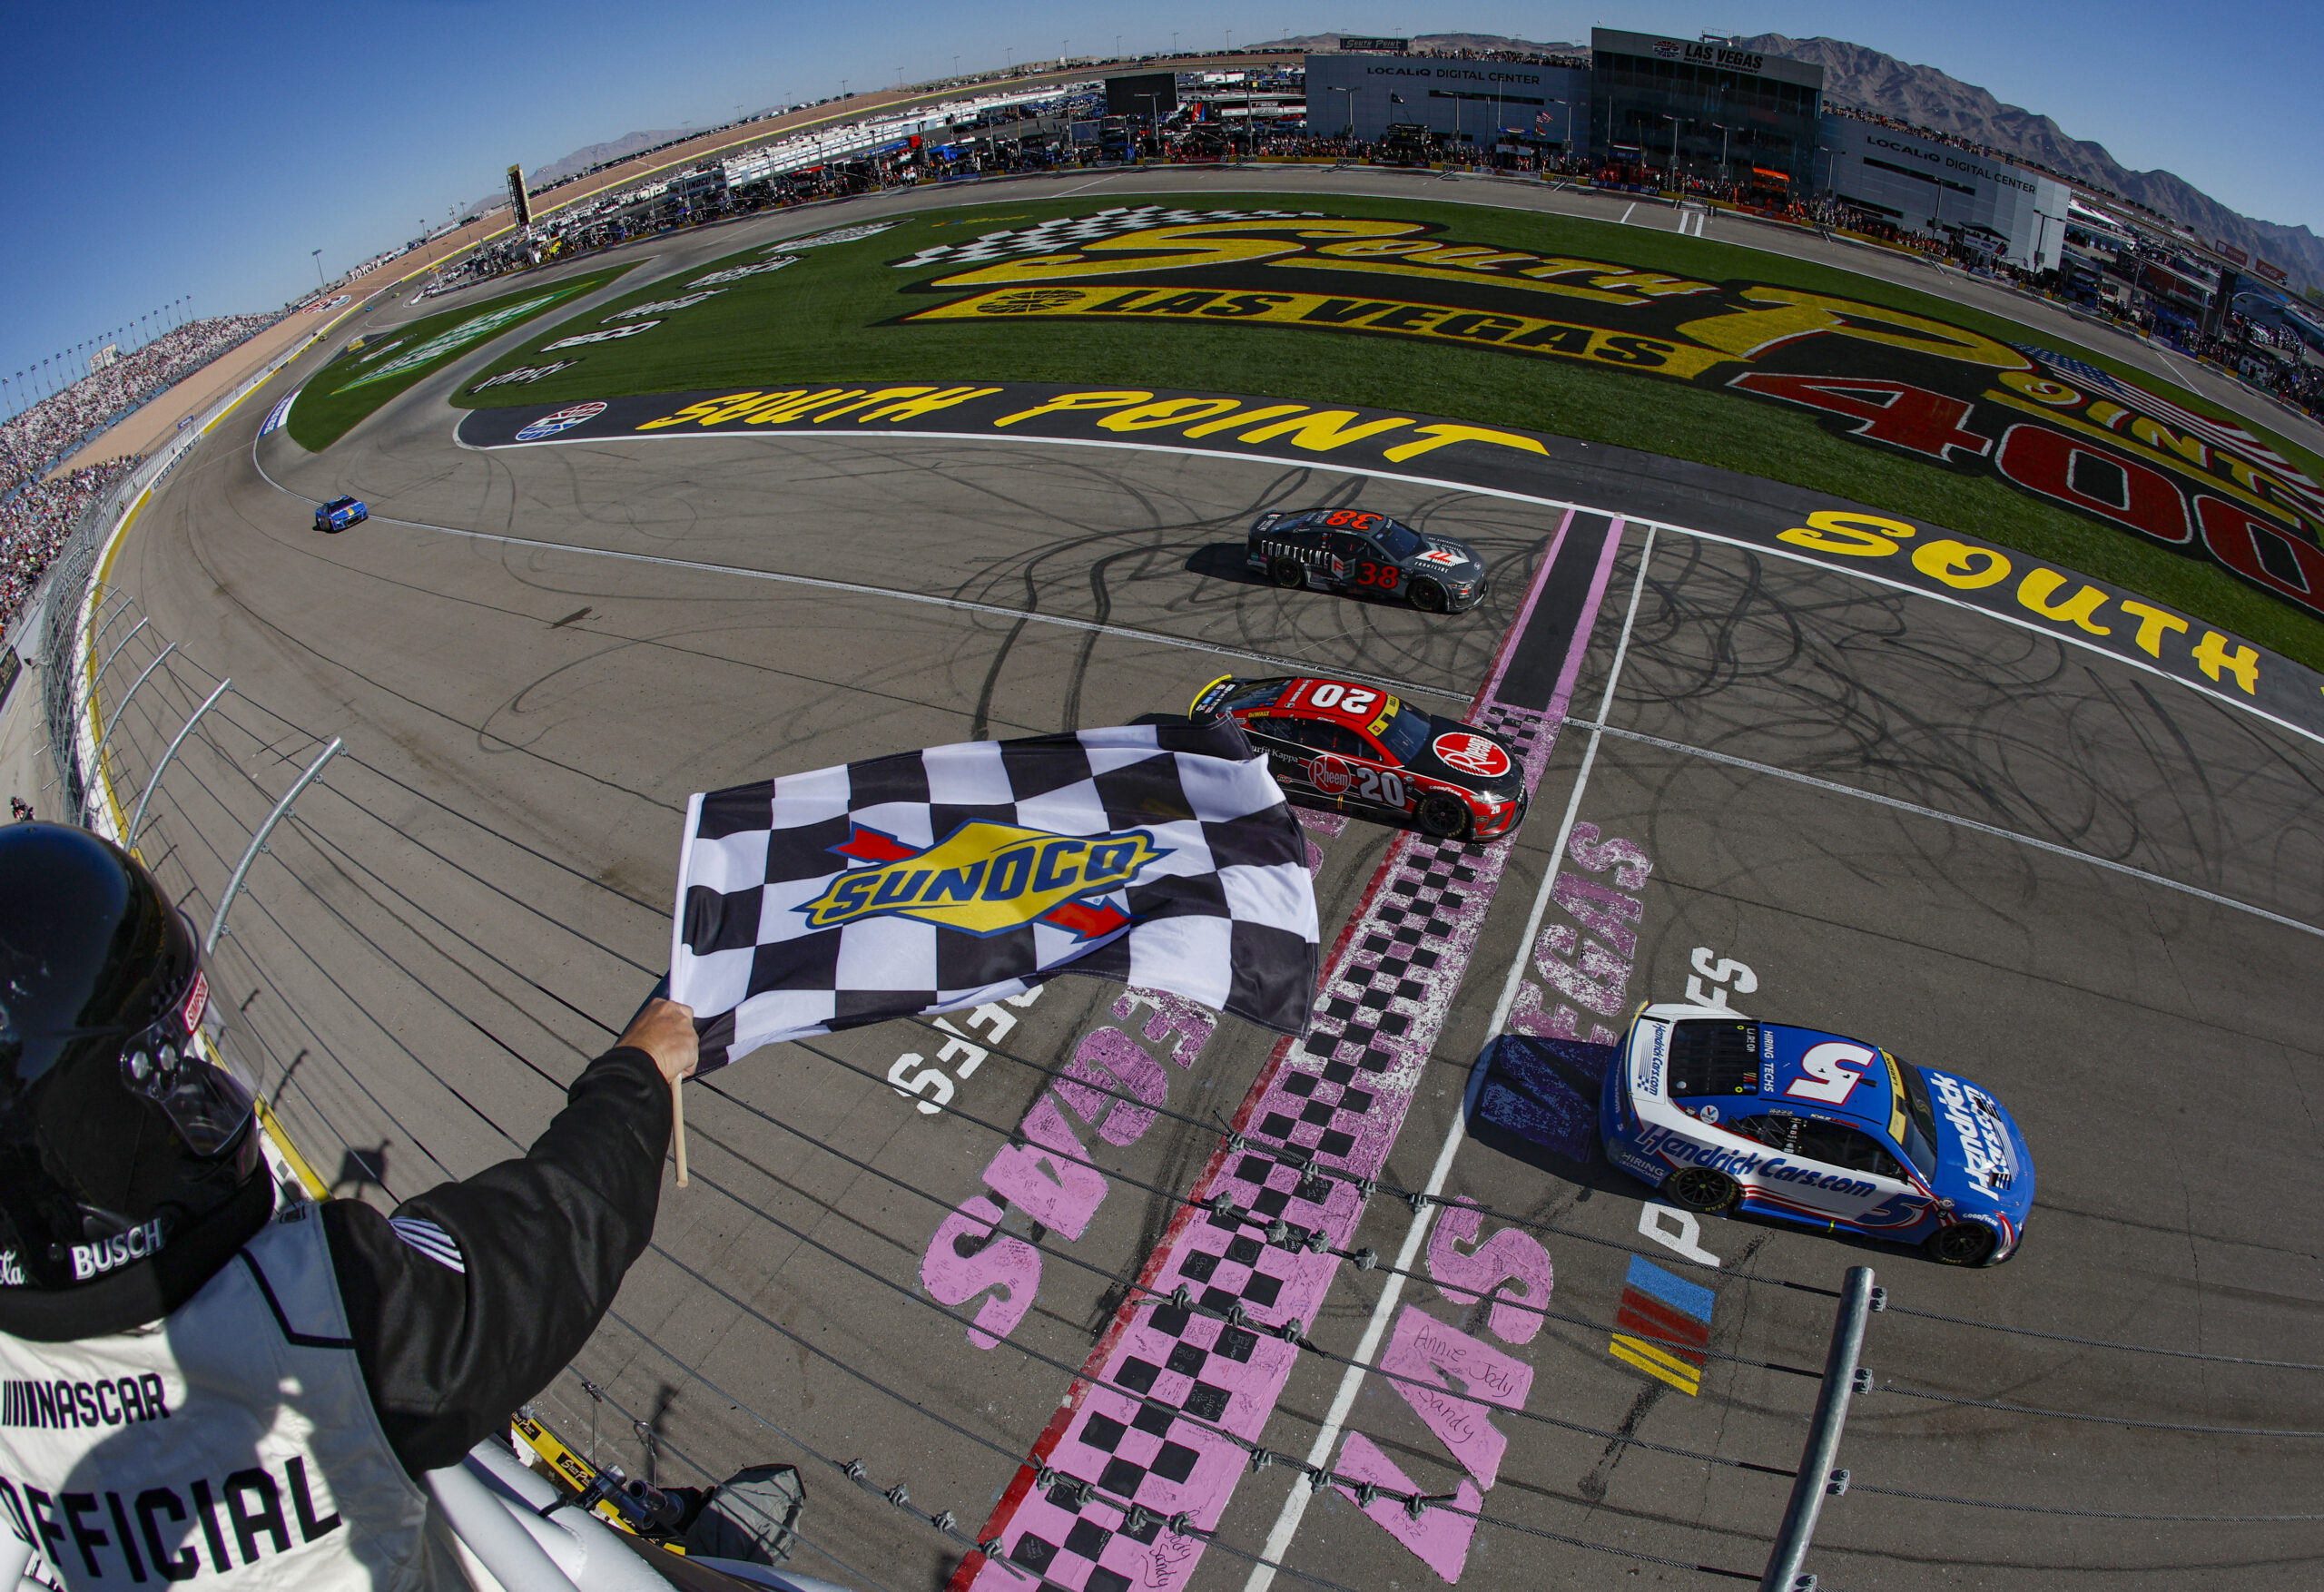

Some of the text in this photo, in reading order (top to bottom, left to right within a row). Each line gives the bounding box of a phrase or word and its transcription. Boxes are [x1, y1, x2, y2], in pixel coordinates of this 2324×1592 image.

[1683, 57, 1759, 74] MOTOR SPEEDWAY
[1684, 44, 1764, 70] LAS VEGAS
[1436, 69, 1485, 81] DIGITAL
[1489, 72, 1541, 85] CENTER
[1945, 156, 1991, 180] DIGITAL
[1994, 172, 2036, 194] CENTER
[350, 259, 383, 281] TOYOTA
[1081, 289, 1677, 367] LAS VEGAS
[994, 390, 1551, 464] POINT
[1727, 370, 2324, 623] 400
[1325, 509, 1384, 531] 38
[1261, 539, 1330, 566] FRONTLINE
[1357, 562, 1399, 589] 38
[1777, 509, 2261, 697] SOUTH
[1310, 683, 1377, 715] 20
[1251, 744, 1299, 763] urfit Kappa
[1313, 755, 1349, 788] Rheem
[1435, 736, 1498, 775] Rheem
[1355, 766, 1406, 808] 20
[1428, 785, 1462, 797] GOODYEAR
[1491, 804, 1502, 815] 20
[823, 840, 1138, 920] SUNOCO
[187, 978, 208, 1027] SIMPSON
[1652, 1022, 1667, 1097] HendrickCars.com
[1763, 1030, 1774, 1093] HIRING TECHS
[1784, 1041, 1877, 1106] 5
[919, 985, 1225, 1351] EGAS
[1619, 1159, 1667, 1182] TECHNICIANS
[1620, 1151, 1666, 1177] HIRING
[1635, 1123, 1876, 1199] HendrickCars.com
[1854, 1192, 1935, 1227] 5
[1962, 1213, 1999, 1226] GOODYEAR
[71, 1217, 164, 1281] BUSCH
[1413, 1324, 1467, 1361] Annie
[1468, 1361, 1513, 1398] Jody
[28, 1372, 171, 1430] NASCAR
[1418, 1379, 1474, 1444] Sandy
